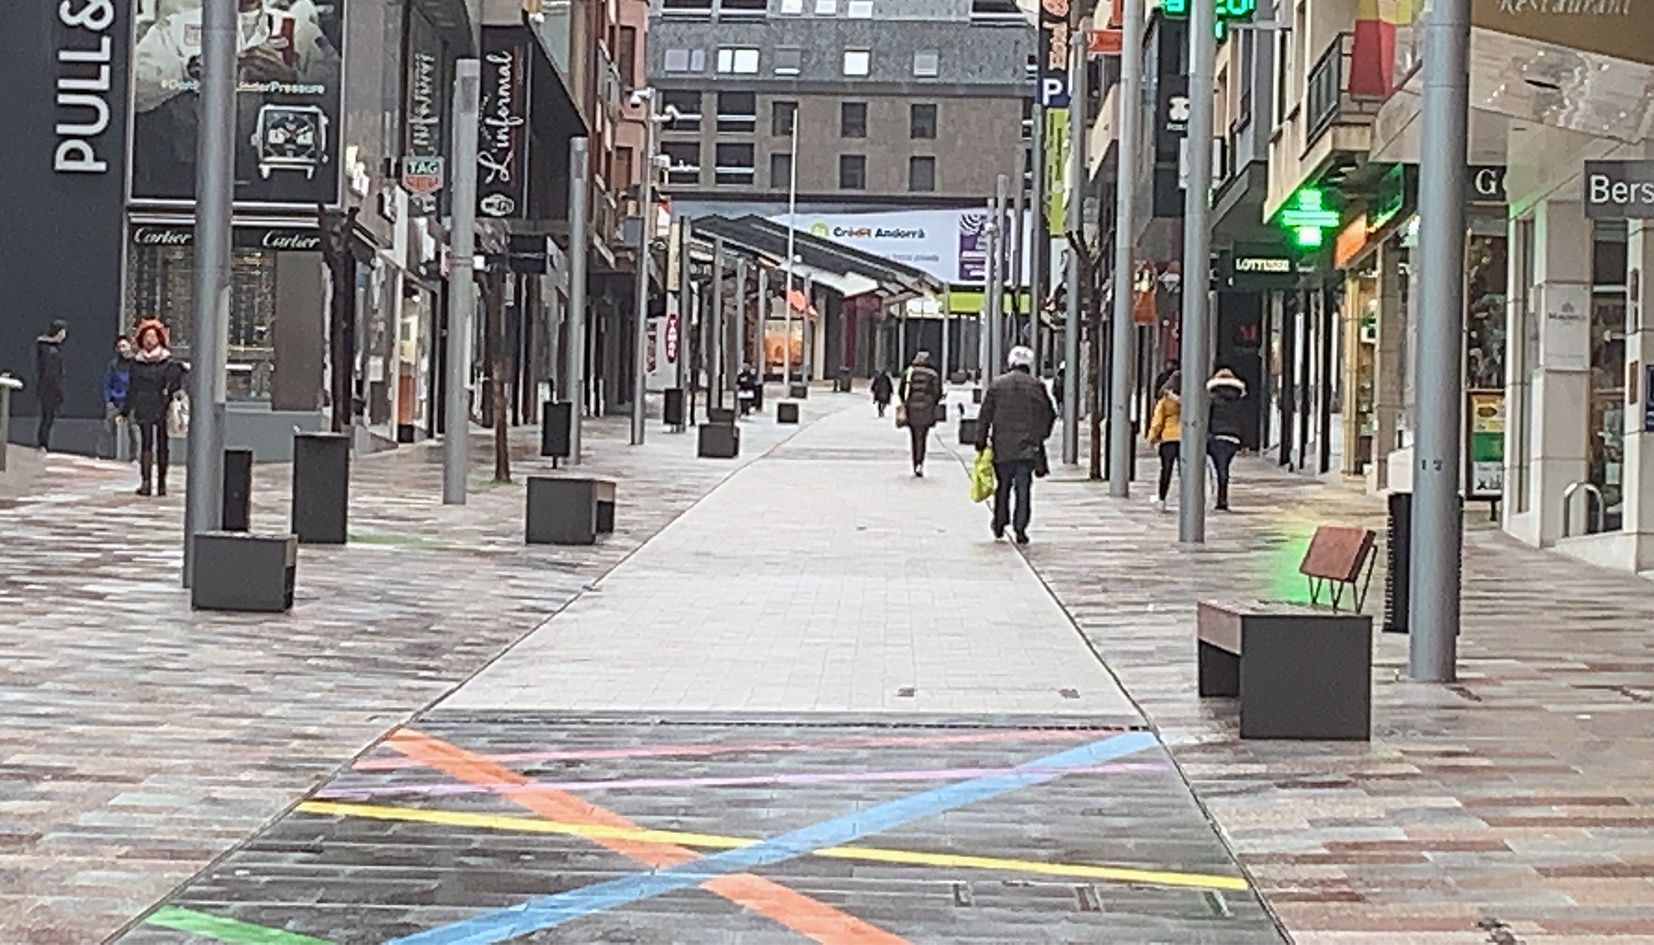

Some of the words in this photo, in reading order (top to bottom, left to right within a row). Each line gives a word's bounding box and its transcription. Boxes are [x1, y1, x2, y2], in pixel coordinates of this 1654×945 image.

[1042, 78, 1063, 105] P
[408, 161, 438, 174] TAG
[133, 228, 192, 245] Cartier
[262, 230, 320, 249] Cartier
